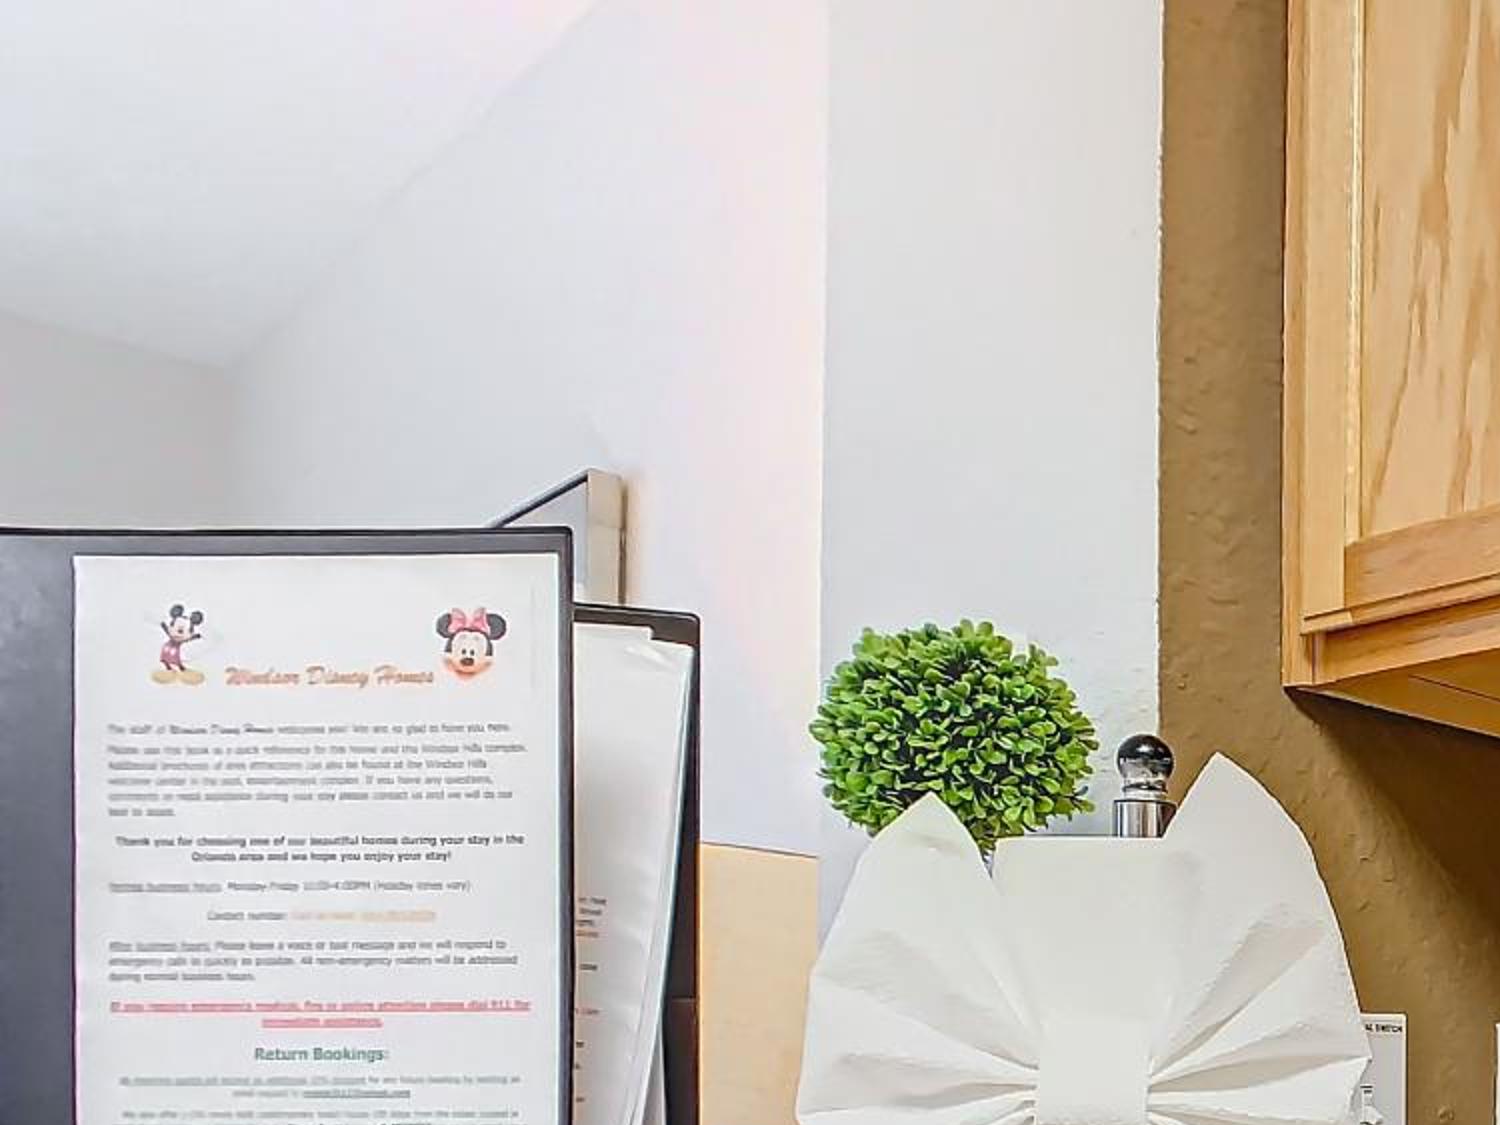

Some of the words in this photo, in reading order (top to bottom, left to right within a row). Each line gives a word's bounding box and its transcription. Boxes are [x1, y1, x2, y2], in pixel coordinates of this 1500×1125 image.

[225, 666, 300, 686] Windsor
[306, 665, 370, 688] Disney
[374, 664, 434, 685] Homes
[154, 838, 174, 848] you
[177, 836, 192, 846] for
[401, 836, 437, 847] during
[440, 836, 464, 847] your
[468, 836, 490, 846] stay
[506, 834, 525, 845] the
[398, 852, 421, 863] your
[255, 1047, 308, 1061] Return
[313, 1047, 390, 1063] Bookings:
